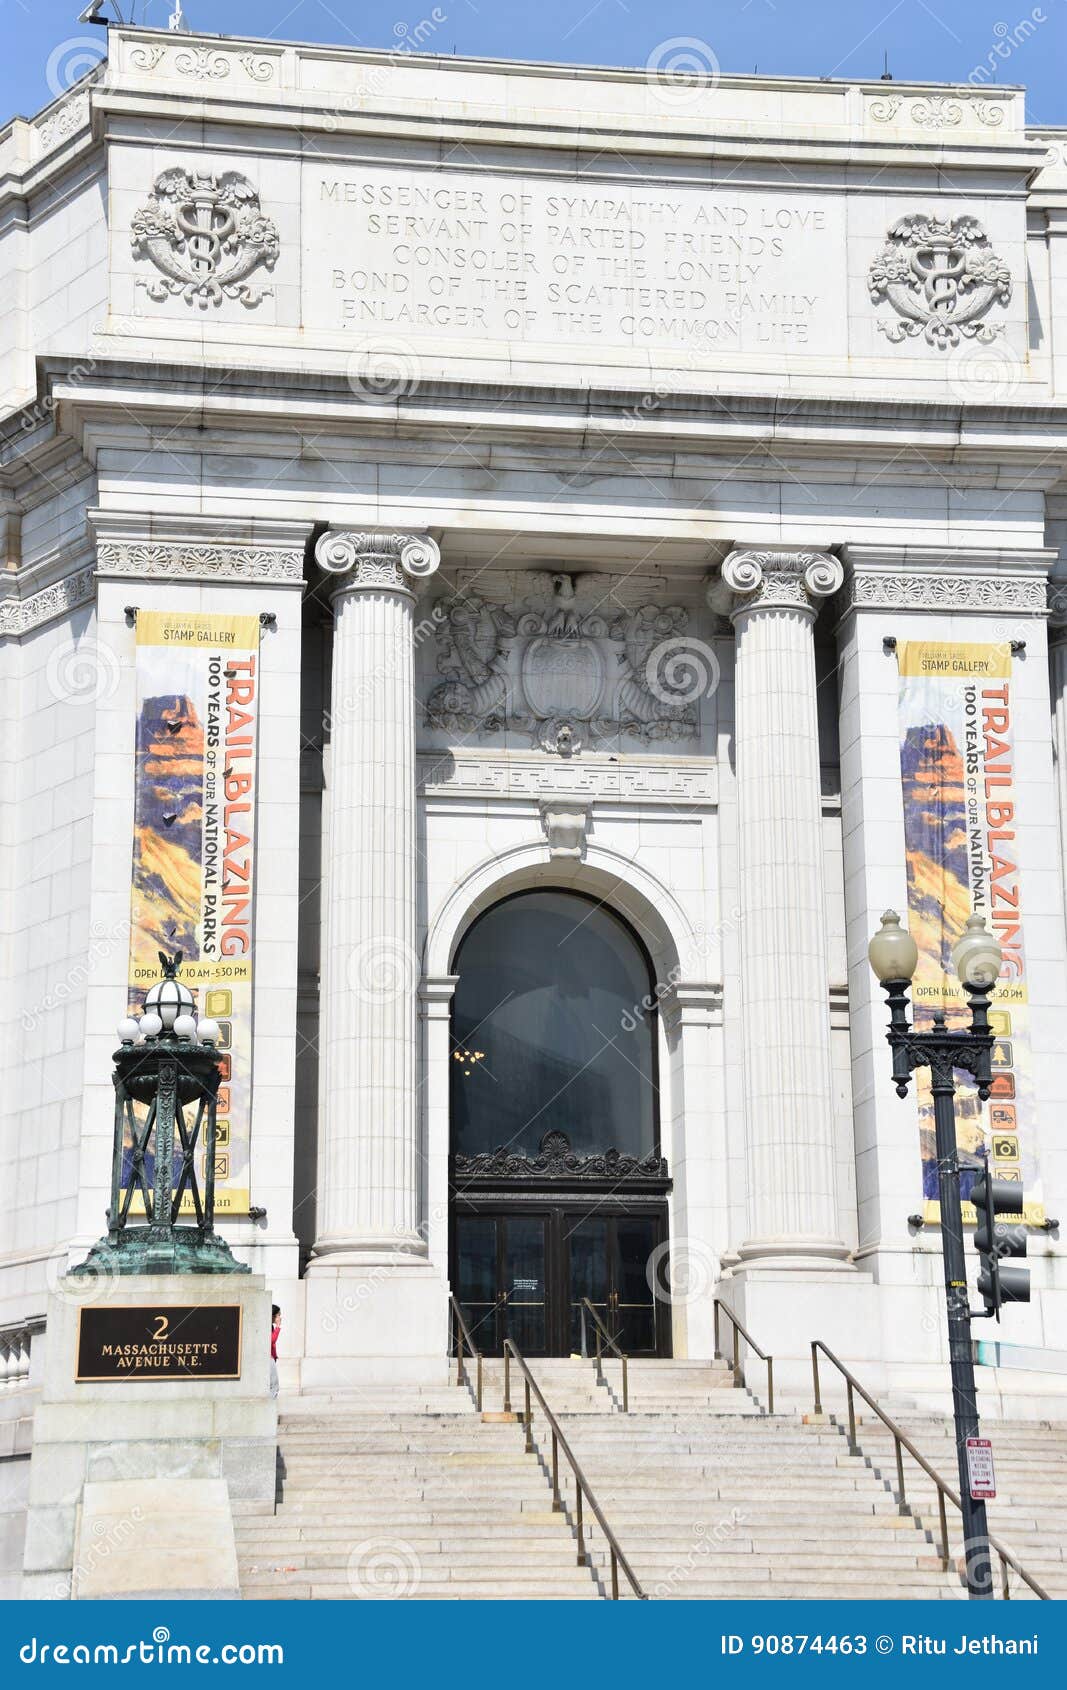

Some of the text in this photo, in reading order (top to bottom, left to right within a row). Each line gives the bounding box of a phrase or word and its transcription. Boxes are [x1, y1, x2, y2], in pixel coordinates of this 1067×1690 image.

[320, 180, 825, 229] MESSENGER OF SYMPATHY AND LOVE
[368, 214, 784, 257] SERVANT OF PARTED FRIENDS
[393, 244, 762, 284] CONSOLER OF THE LONELY
[332, 269, 818, 315] BOND OF THE SCATTERED FAMILY
[341, 299, 808, 343] ENLARGER OF THE COMMON LIFE
[163, 629, 236, 643] STAMP GALLERY
[922, 659, 989, 672] STAMP GALLERY
[203, 655, 221, 953] 100 YEARS OF OUR NATIONAL PARKS
[220, 654, 256, 956] TRAILBLAZING
[964, 685, 985, 912] 100 YEARS OF OUR NATIONAL
[981, 683, 1024, 978] TRAILBLAZING
[134, 968, 158, 978] OPEN
[186, 968, 196, 978] 10
[235, 967, 247, 977] PM
[916, 987, 939, 996] OPEN
[1011, 989, 1023, 998] PM
[152, 1315, 169, 1341] 2
[101, 1343, 218, 1356] MASSACHUSETTS
[116, 1355, 203, 1368] AVENUE N.E.
